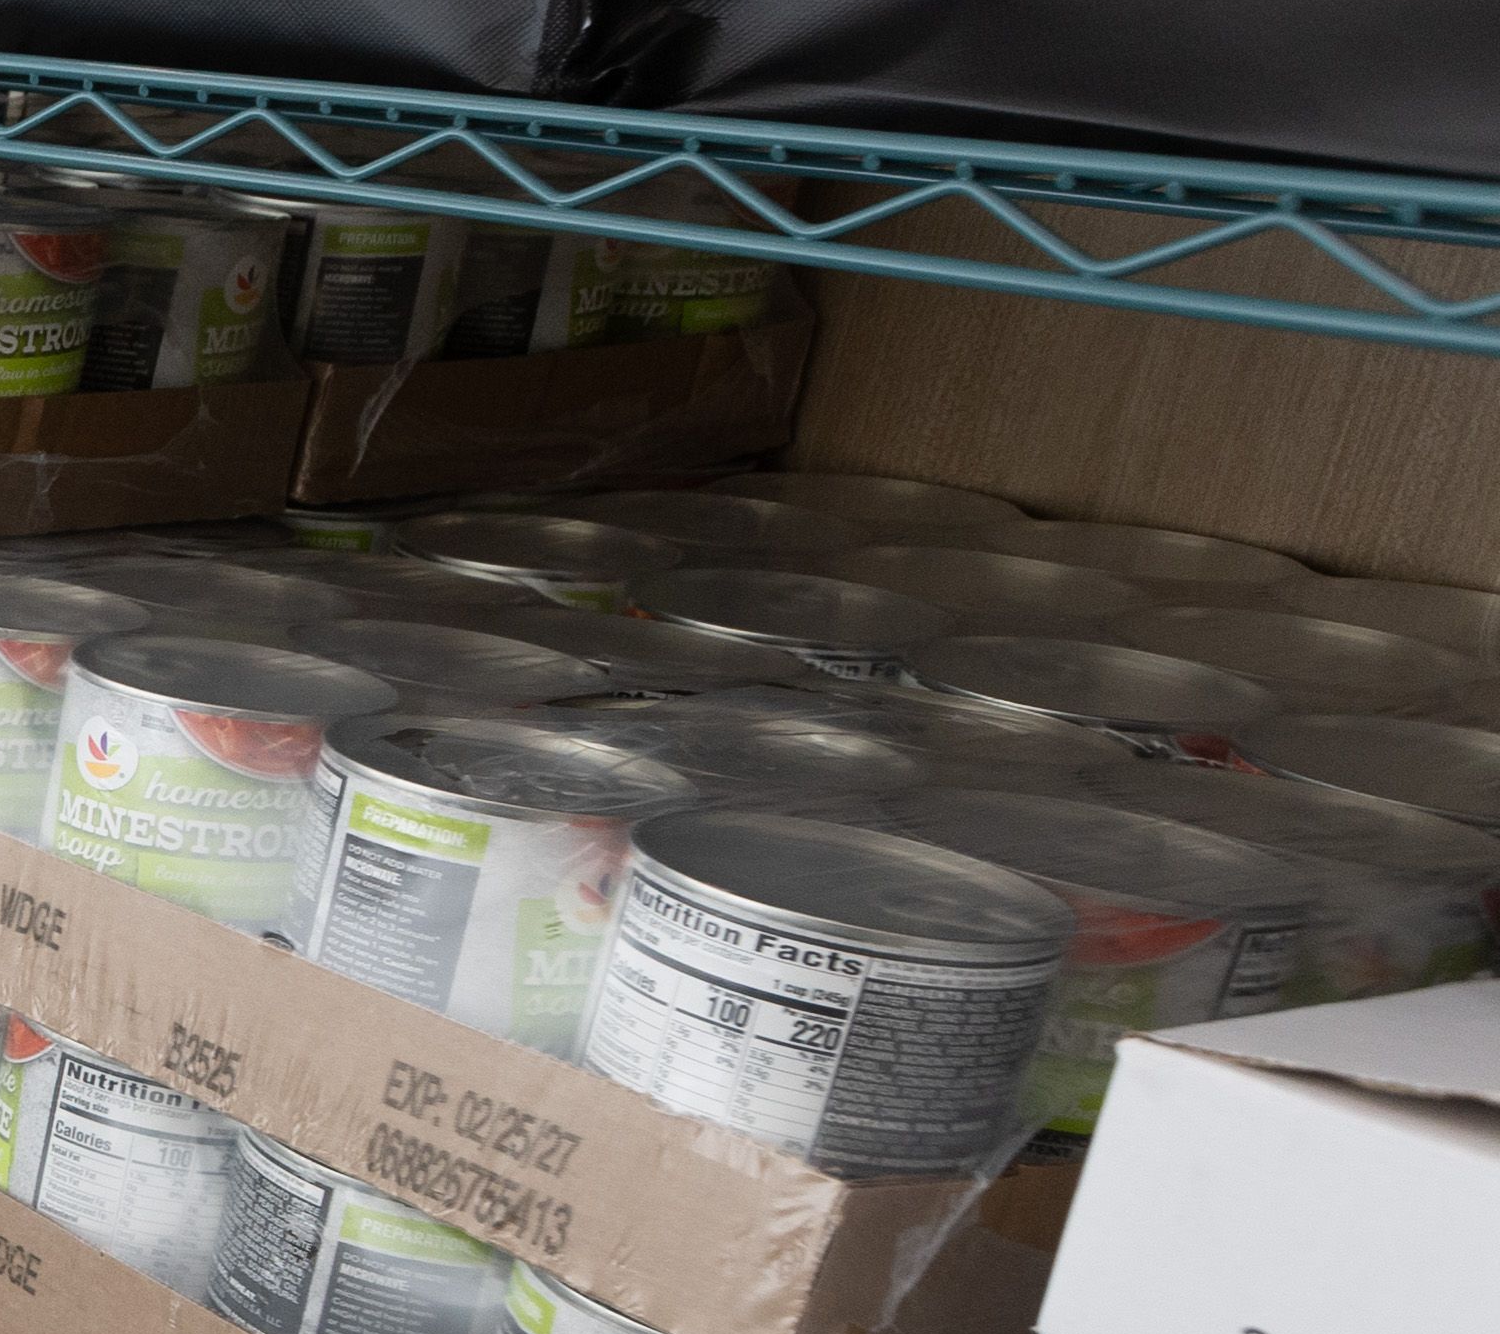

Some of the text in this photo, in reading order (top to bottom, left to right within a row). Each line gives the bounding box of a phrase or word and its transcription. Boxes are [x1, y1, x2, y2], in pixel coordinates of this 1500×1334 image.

[57, 828, 125, 871] soup
[363, 805, 468, 849] PREPARATION:
[405, 863, 443, 881] WATER
[0, 882, 67, 952] WDGE
[632, 877, 862, 977] Nutrition Facts
[707, 995, 842, 1051] 100 220
[66, 1062, 182, 1107] Nutrition
[163, 1021, 243, 1098] B2525
[55, 1119, 192, 1168] Calories 100
[381, 1059, 583, 1179] EXP: 02/25/27
